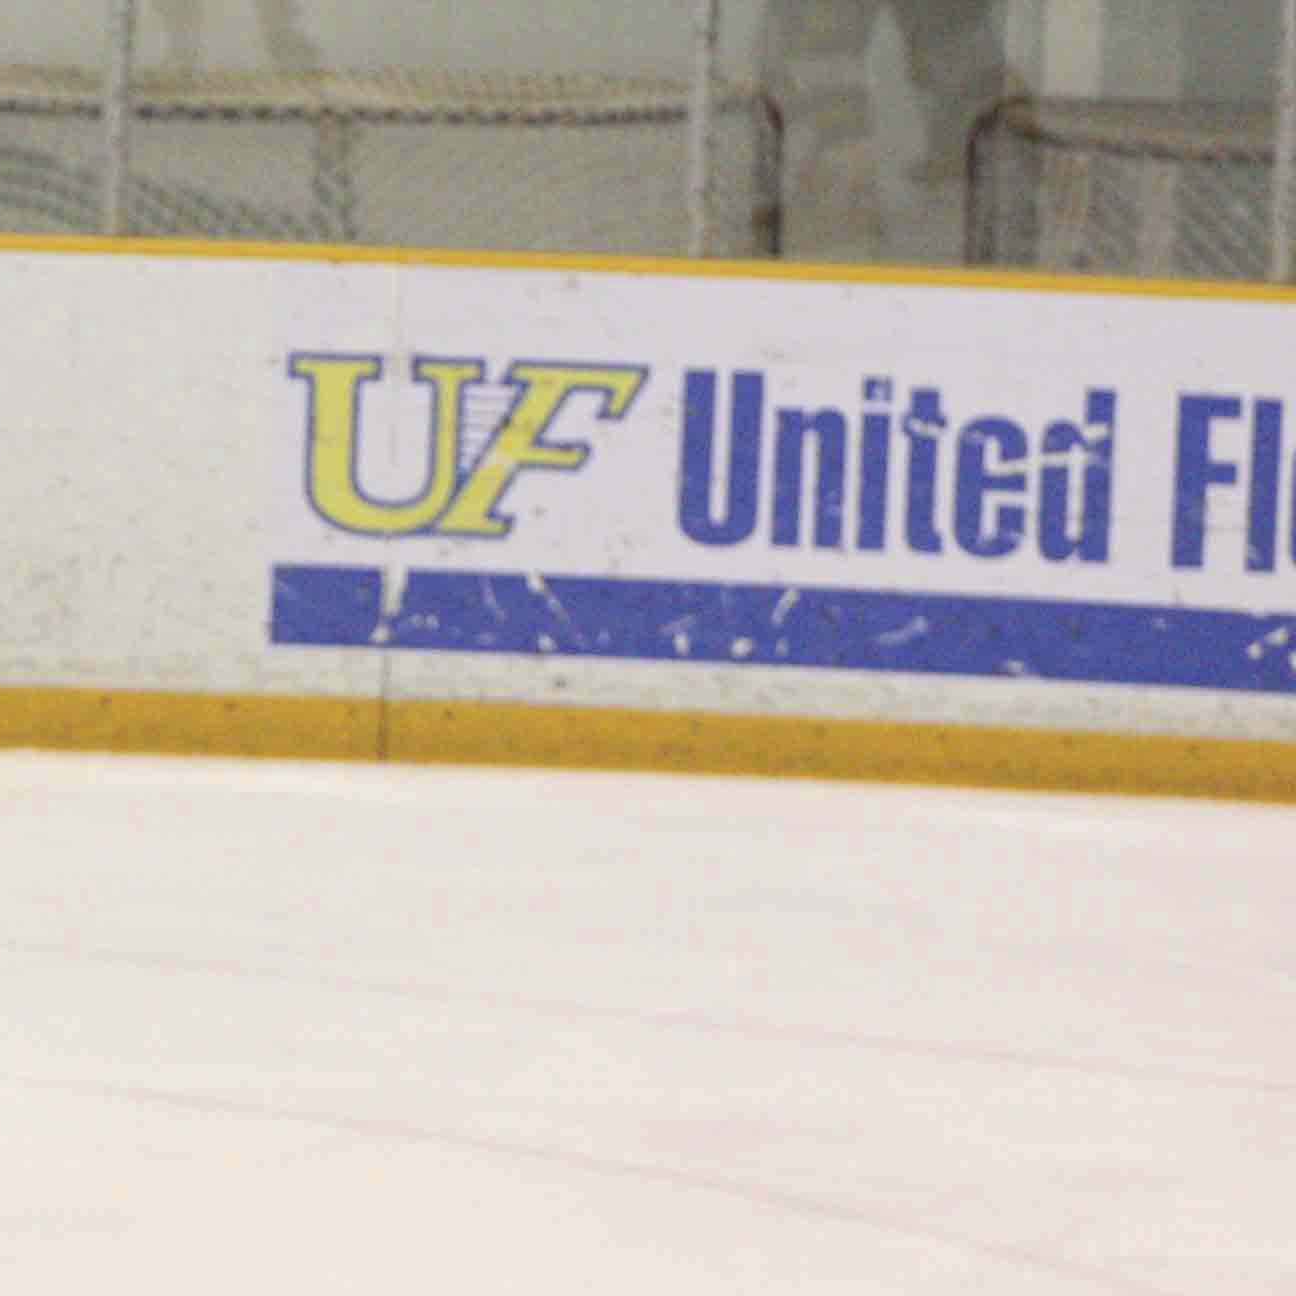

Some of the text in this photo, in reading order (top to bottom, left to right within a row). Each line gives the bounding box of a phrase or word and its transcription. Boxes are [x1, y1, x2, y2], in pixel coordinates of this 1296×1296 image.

[287, 351, 650, 540] UF
[676, 369, 1296, 572] United Fl
